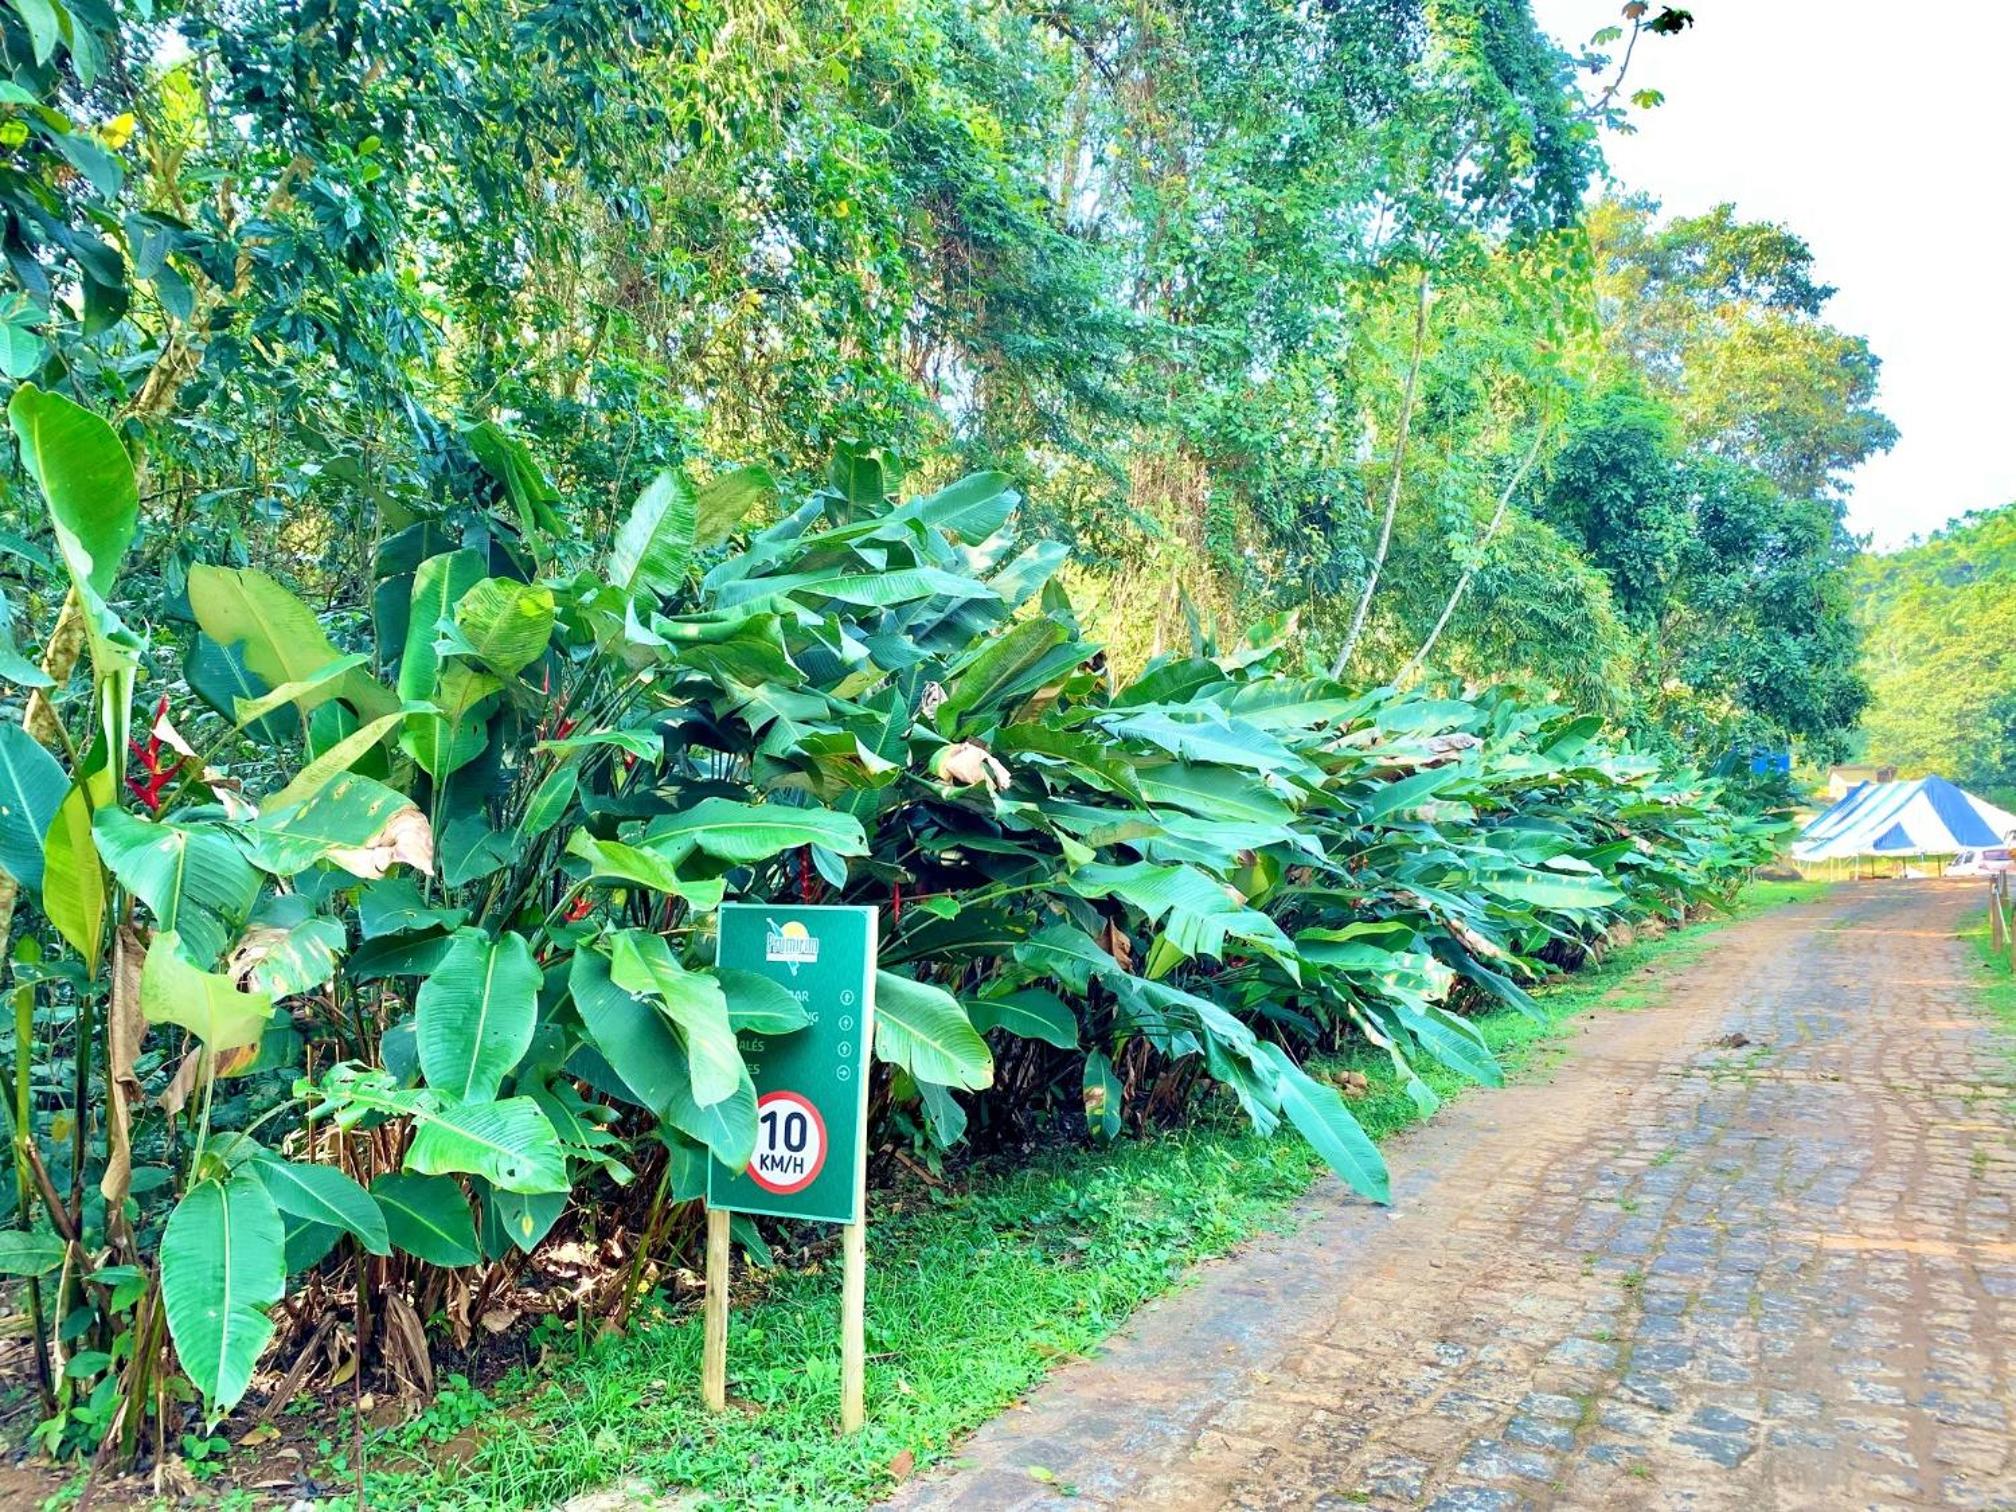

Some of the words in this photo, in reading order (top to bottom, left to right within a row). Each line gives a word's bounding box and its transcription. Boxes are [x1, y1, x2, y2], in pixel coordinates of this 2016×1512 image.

[738, 1037, 766, 1052] ALÉS
[760, 1110, 807, 1153] 10
[760, 1153, 804, 1174] KM/H
